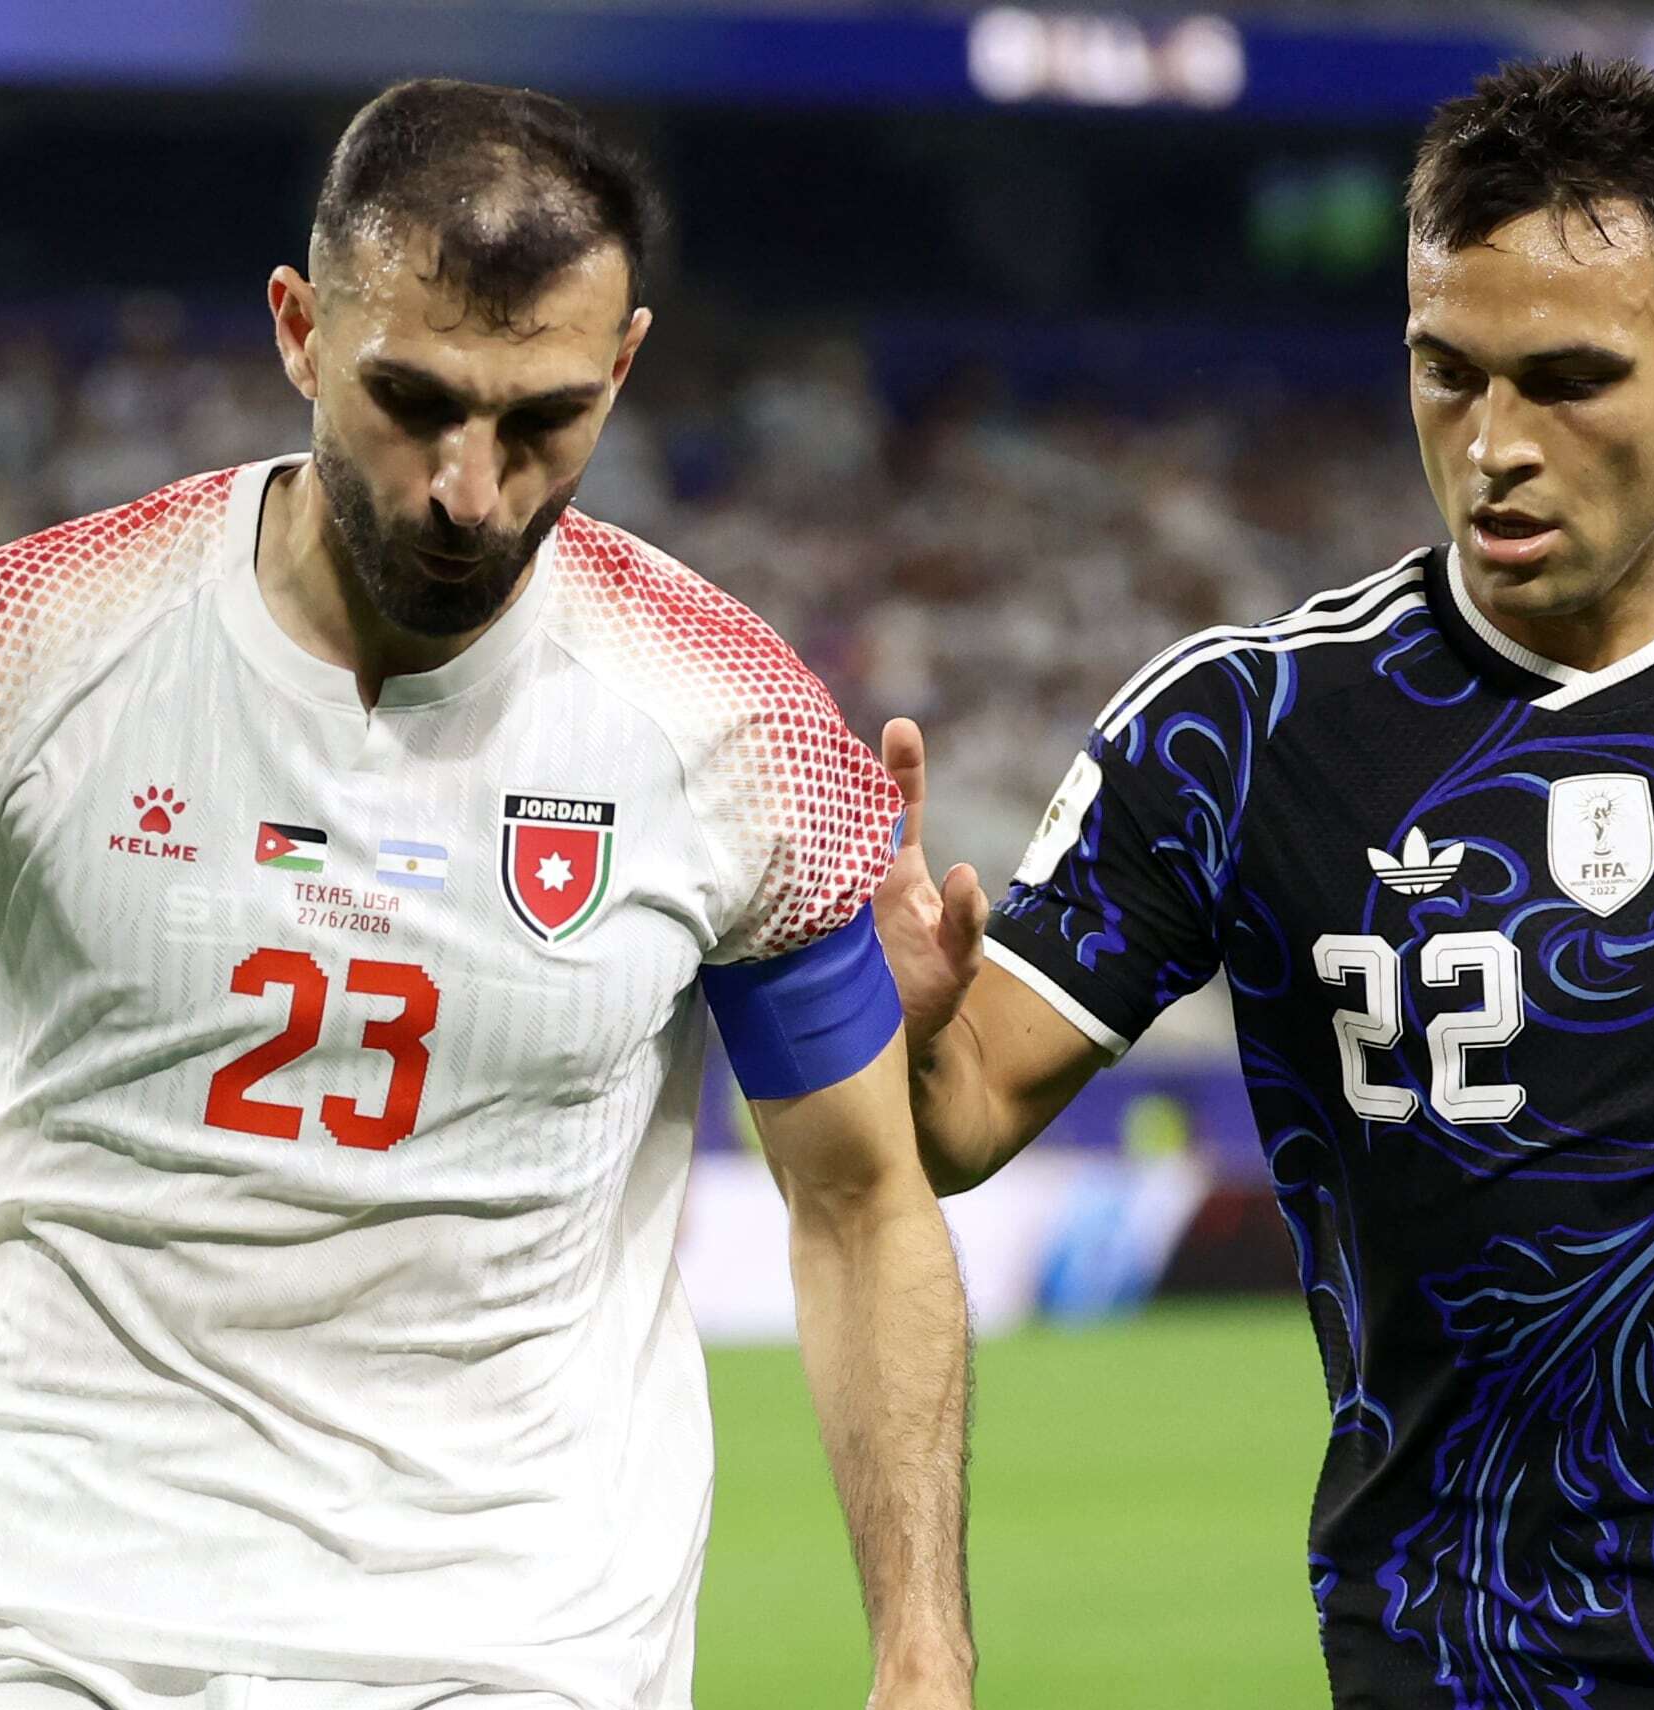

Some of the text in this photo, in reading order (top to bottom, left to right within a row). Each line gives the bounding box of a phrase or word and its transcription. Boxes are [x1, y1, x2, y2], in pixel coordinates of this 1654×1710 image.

[516, 798, 603, 823] JORDAN
[108, 834, 198, 863] KELME
[1581, 862, 1627, 879] FIFA
[362, 892, 401, 913] USA
[297, 907, 392, 935] 27/6/2026
[1312, 930, 1526, 1125] 22
[204, 947, 440, 1151] 23
